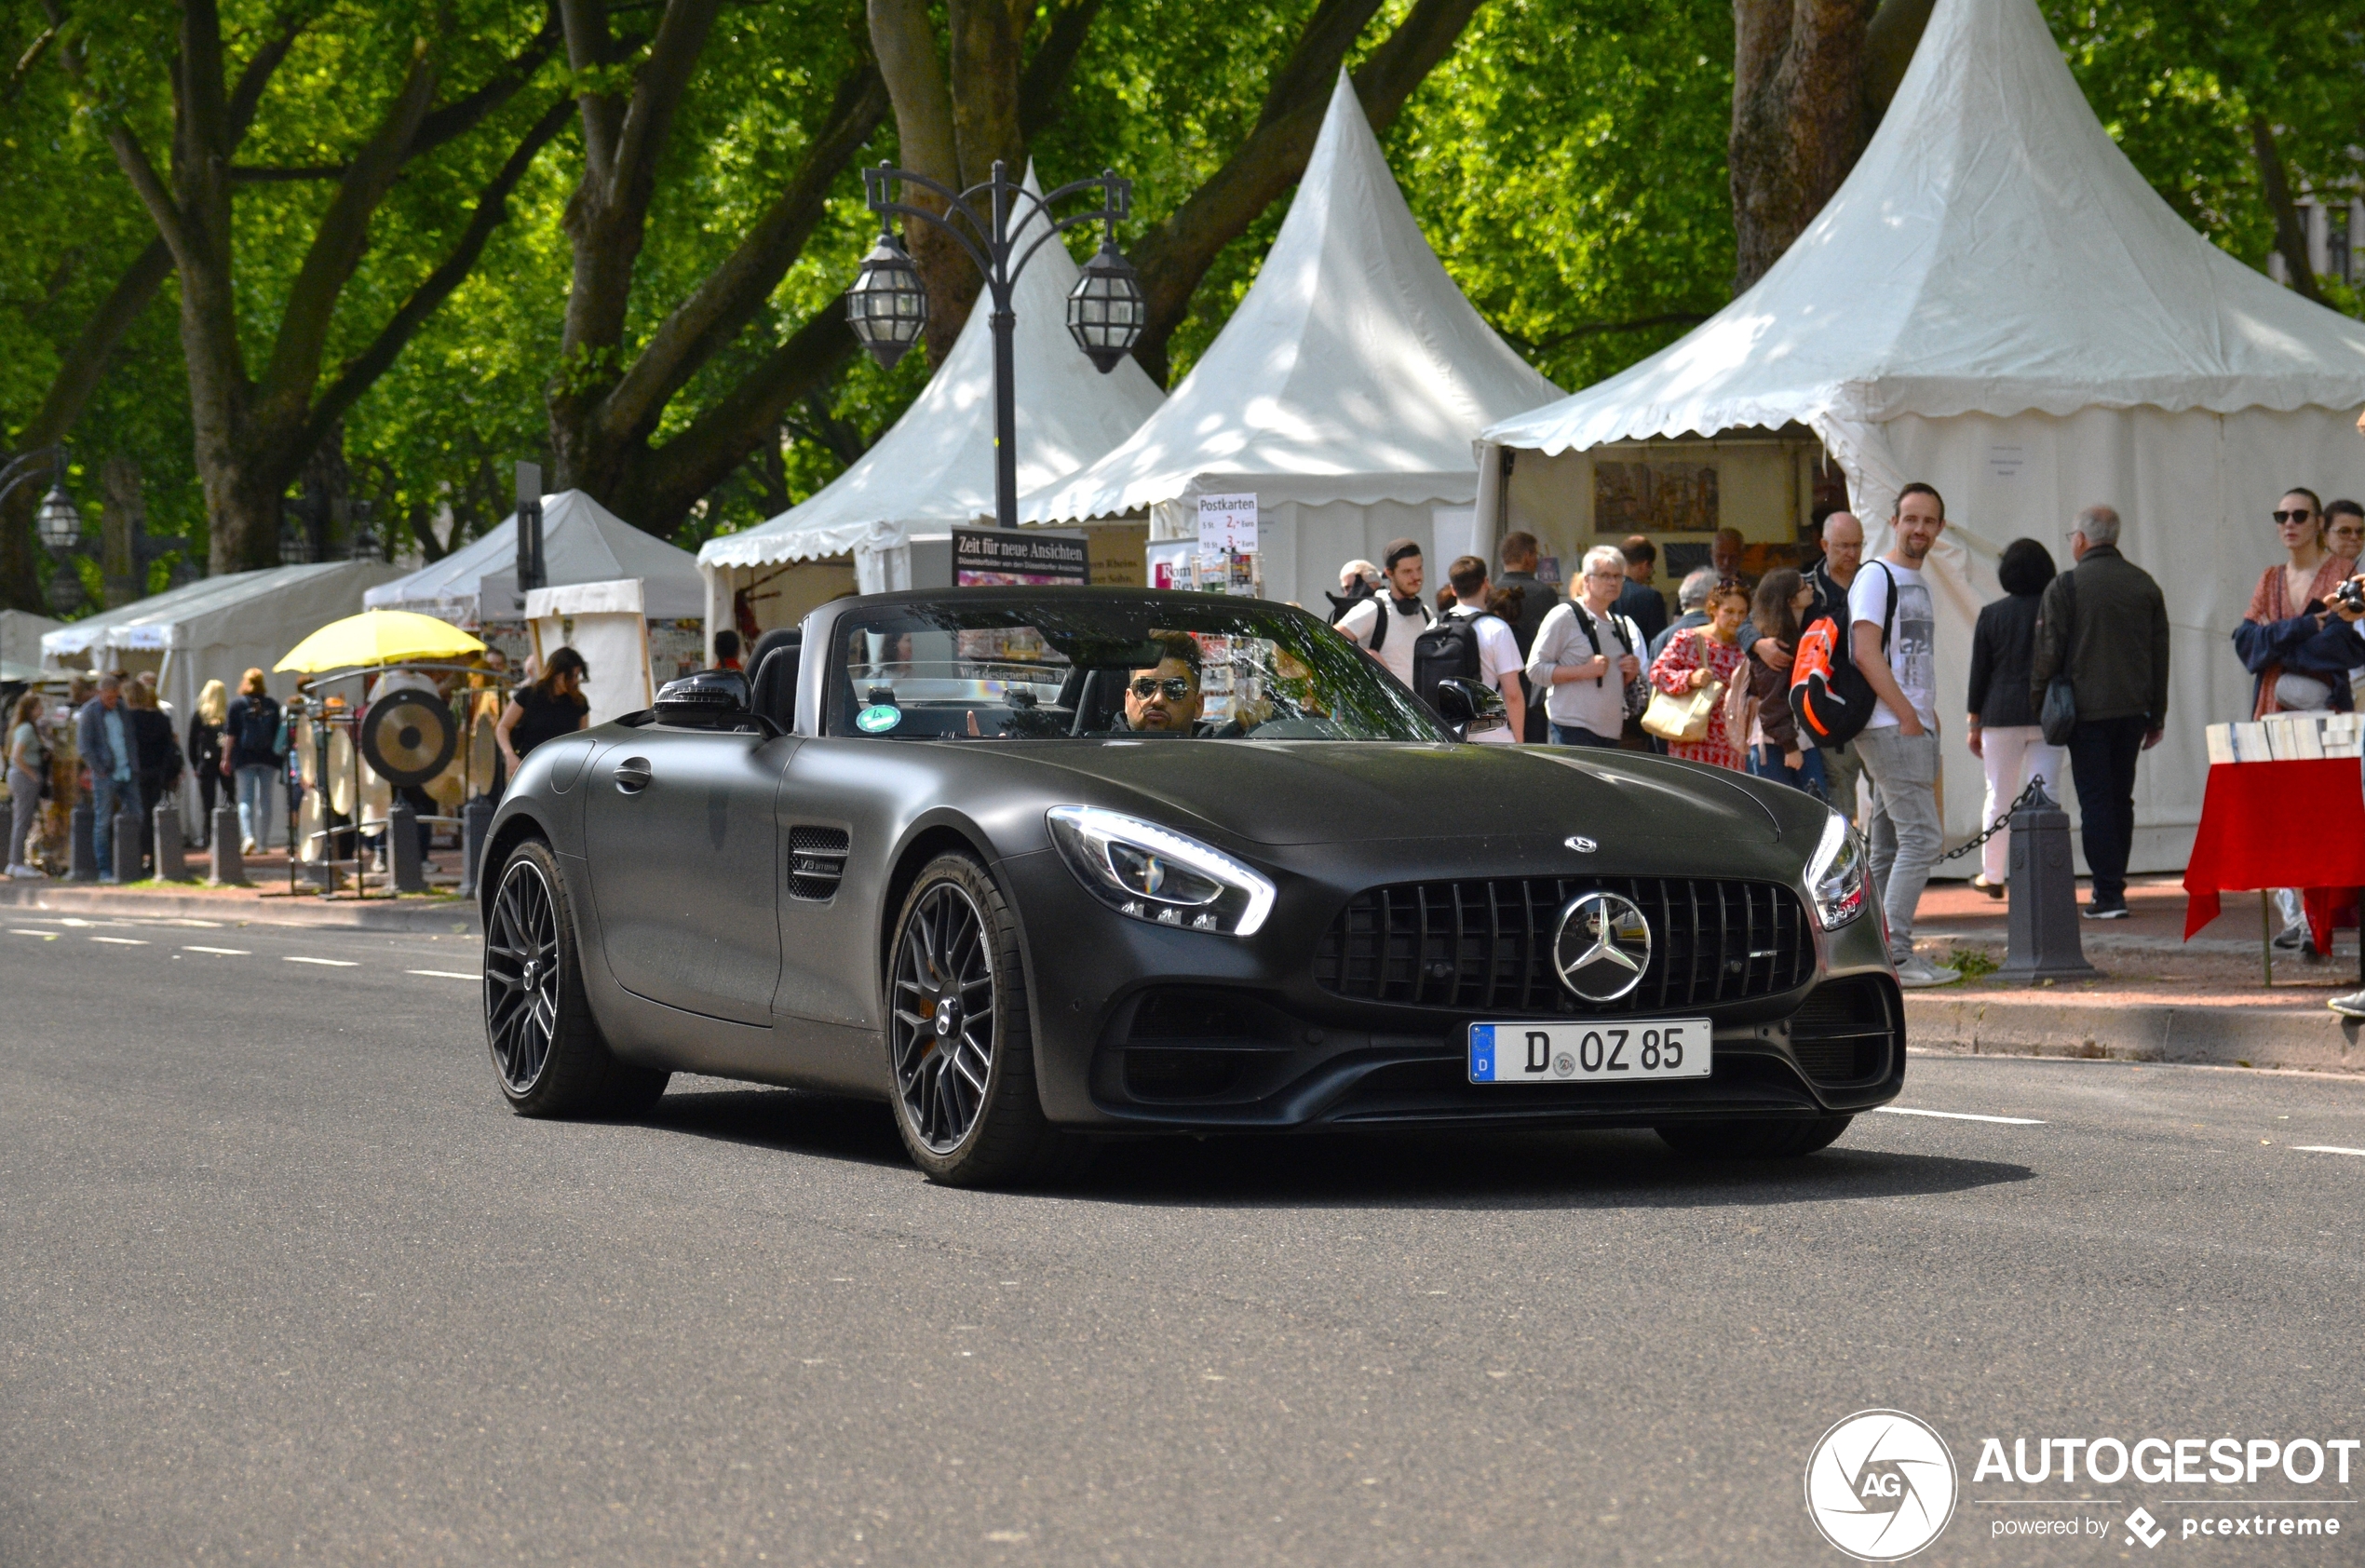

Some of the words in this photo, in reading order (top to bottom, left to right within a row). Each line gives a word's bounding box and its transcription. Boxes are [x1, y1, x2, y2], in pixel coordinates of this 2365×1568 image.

[1200, 497, 1255, 511] Postkarten
[1241, 520, 1255, 528] Euro
[958, 535, 981, 554] Zeit
[982, 536, 1000, 556] für
[1001, 543, 1029, 558] neue
[1030, 542, 1083, 561] Ansichten
[959, 666, 980, 679] Wir
[982, 668, 1030, 682] designen
[872, 710, 883, 719] 4
[801, 858, 815, 870] V8
[1525, 1031, 1550, 1073] D
[1580, 1030, 1629, 1073] OZ
[1641, 1028, 1683, 1071] 85
[1479, 1060, 1488, 1072] D
